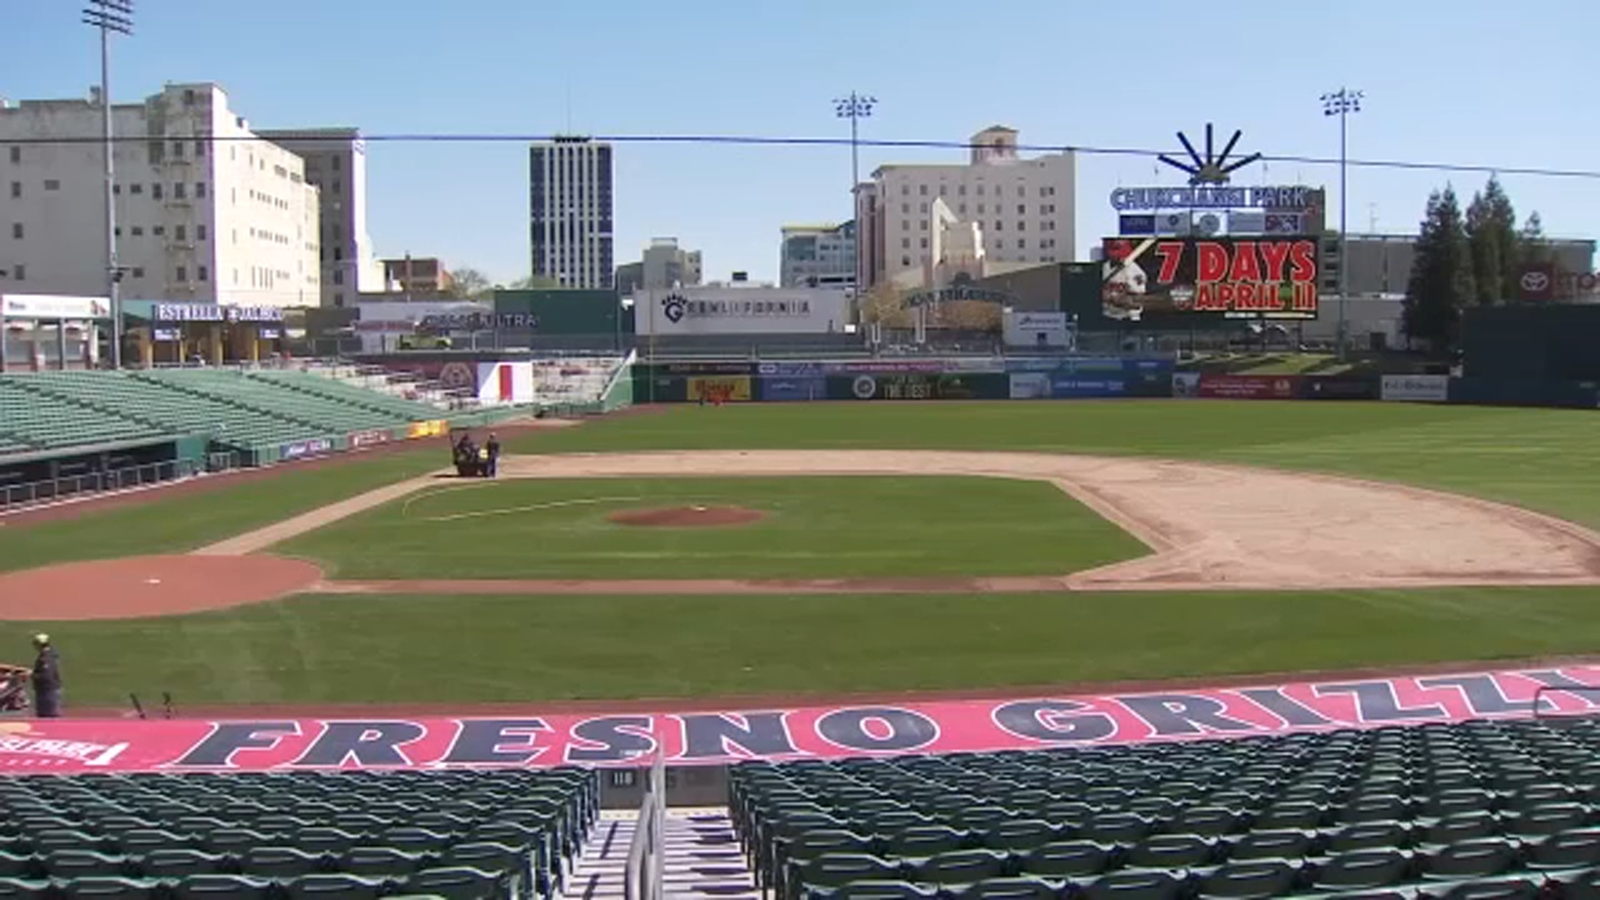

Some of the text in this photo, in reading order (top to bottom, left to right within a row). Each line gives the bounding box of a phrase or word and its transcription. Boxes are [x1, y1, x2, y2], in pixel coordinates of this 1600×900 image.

[1252, 186, 1309, 208] PARK
[1155, 242, 1316, 284] 7 DAYS
[1193, 282, 1284, 311] APRIL
[156, 705, 941, 769] FRESNO
